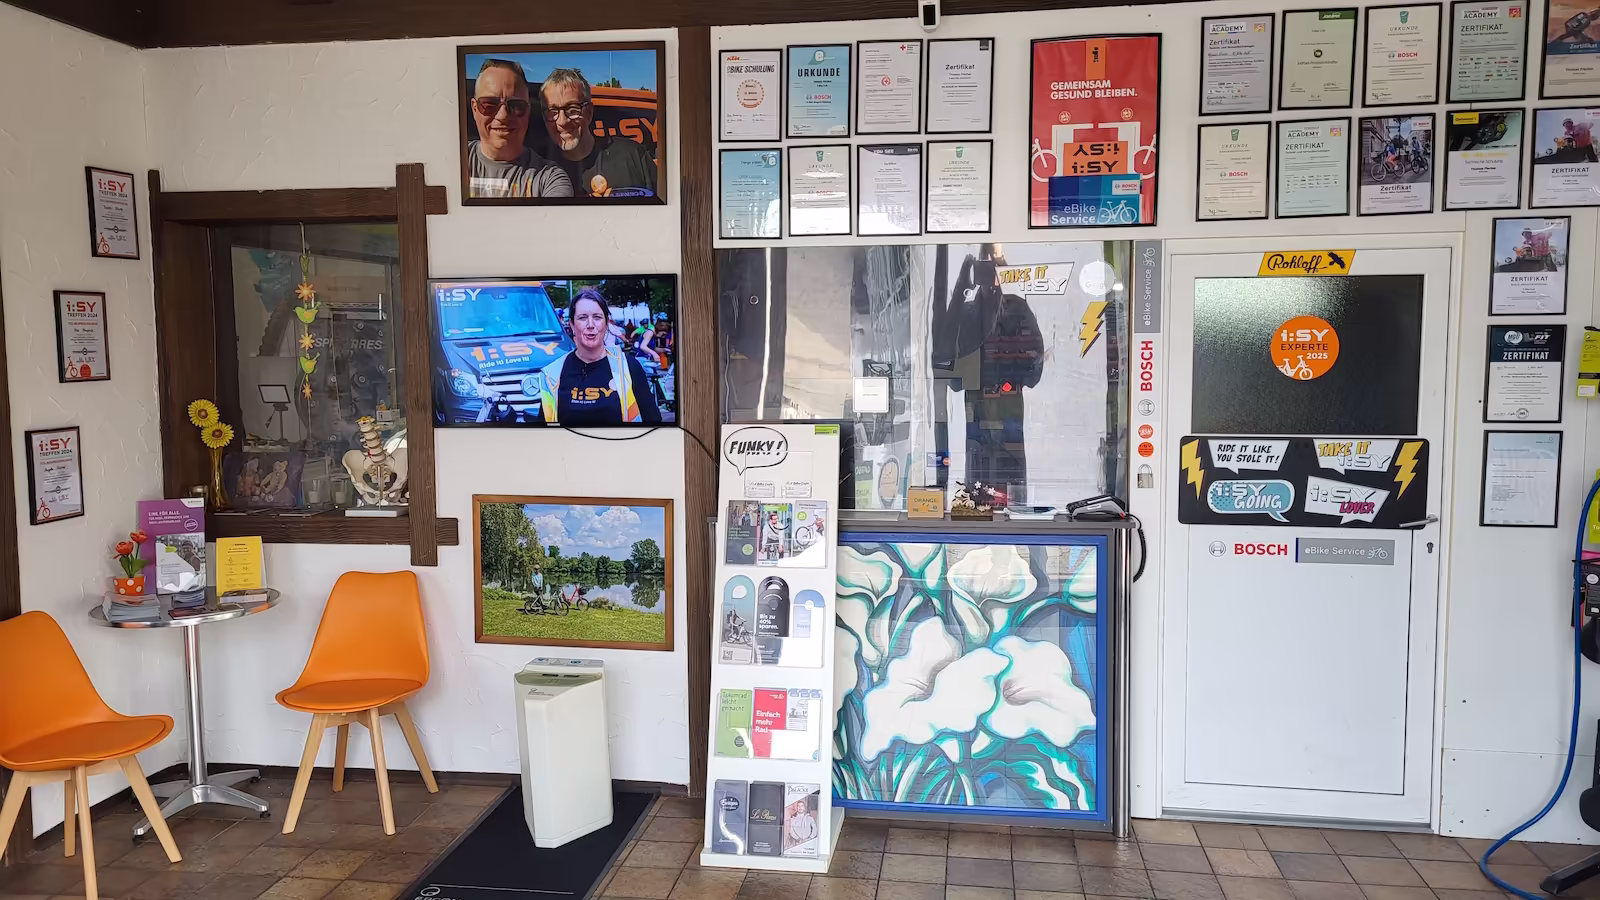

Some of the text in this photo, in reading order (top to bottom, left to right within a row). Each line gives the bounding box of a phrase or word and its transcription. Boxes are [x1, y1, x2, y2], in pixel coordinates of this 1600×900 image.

[1211, 25, 1244, 33] ACADEMY
[1460, 24, 1504, 32] ZERTIFIKAT
[744, 65, 775, 73] SCHULUNG
[797, 68, 841, 77] URKUNDE
[1050, 80, 1111, 91] GEMEINSAM
[1050, 88, 1138, 100] GESUND BLEIBEN.
[1285, 142, 1325, 150] ZERTIFIKAT
[1072, 161, 1119, 174] i:SY
[98, 179, 127, 193] i:SY
[1064, 203, 1096, 214] eBike
[1051, 214, 1096, 224] Service
[1267, 253, 1327, 274] Rohloff
[1000, 265, 1048, 284] TAKE IT
[438, 288, 481, 301] i:SY
[1143, 268, 1152, 326] eBike Service
[67, 301, 96, 312] i:SY
[1281, 329, 1330, 342] i:SY
[470, 341, 559, 362] i:SY
[1306, 352, 1329, 360] 2025
[1503, 352, 1550, 360] ZERTIFIKAT
[1140, 340, 1153, 391] BOSCH
[571, 387, 614, 400] i:SY
[39, 437, 71, 451] i:SY
[1217, 444, 1273, 454] RIDE IT LIKE
[1318, 440, 1372, 457] TAKE IT
[1217, 453, 1280, 465] YOU STOLE IT!
[1337, 454, 1392, 468] i:SY
[1215, 483, 1267, 498] i:SY
[1310, 483, 1377, 503] i:SY
[1233, 494, 1282, 509] GOING
[1339, 500, 1375, 514] LOVER
[1234, 543, 1365, 556] BOSCH eBike Service
[755, 710, 781, 718] Einfach
